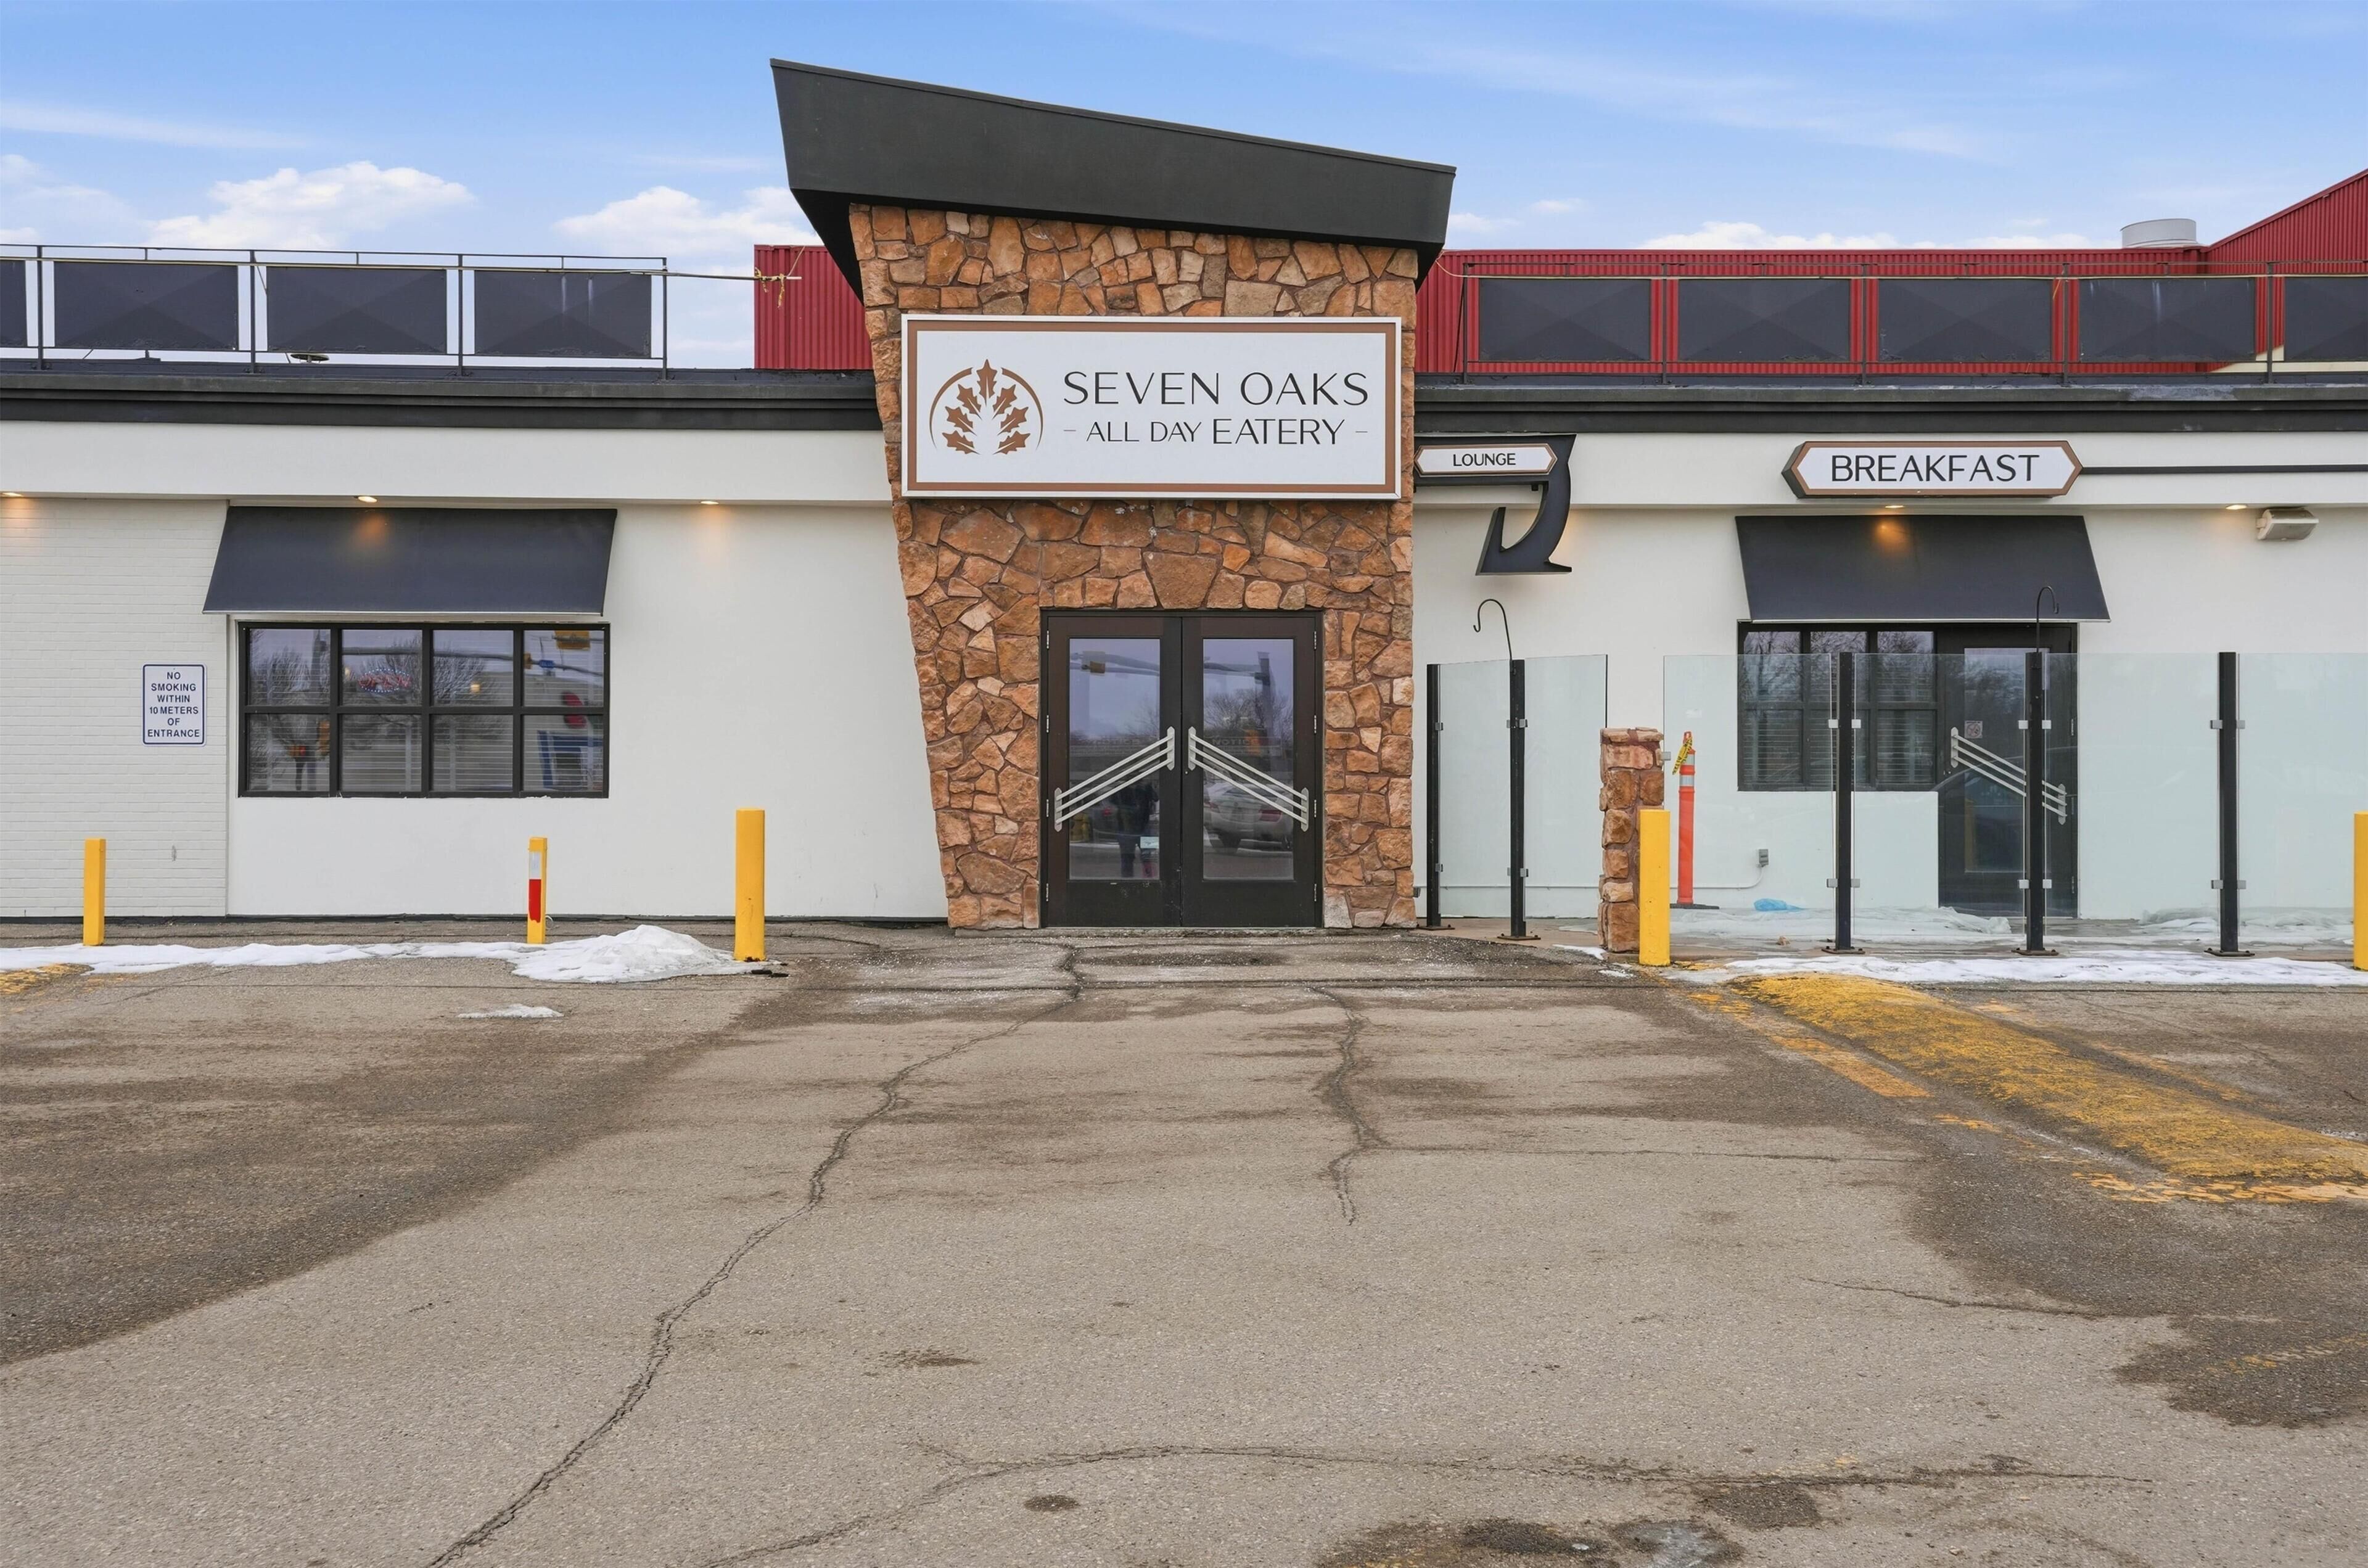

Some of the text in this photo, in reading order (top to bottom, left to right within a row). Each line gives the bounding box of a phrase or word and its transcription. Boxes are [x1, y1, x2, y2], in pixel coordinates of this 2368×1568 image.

[1064, 372, 1367, 405] SEVEN OAKS
[1087, 419, 1344, 444] ALL DAY EATERY
[1453, 453, 1516, 466] LOUNGE
[1832, 455, 2039, 482] BREAKFAST
[152, 683, 195, 691] SMOKING
[168, 718, 179, 726] OF
